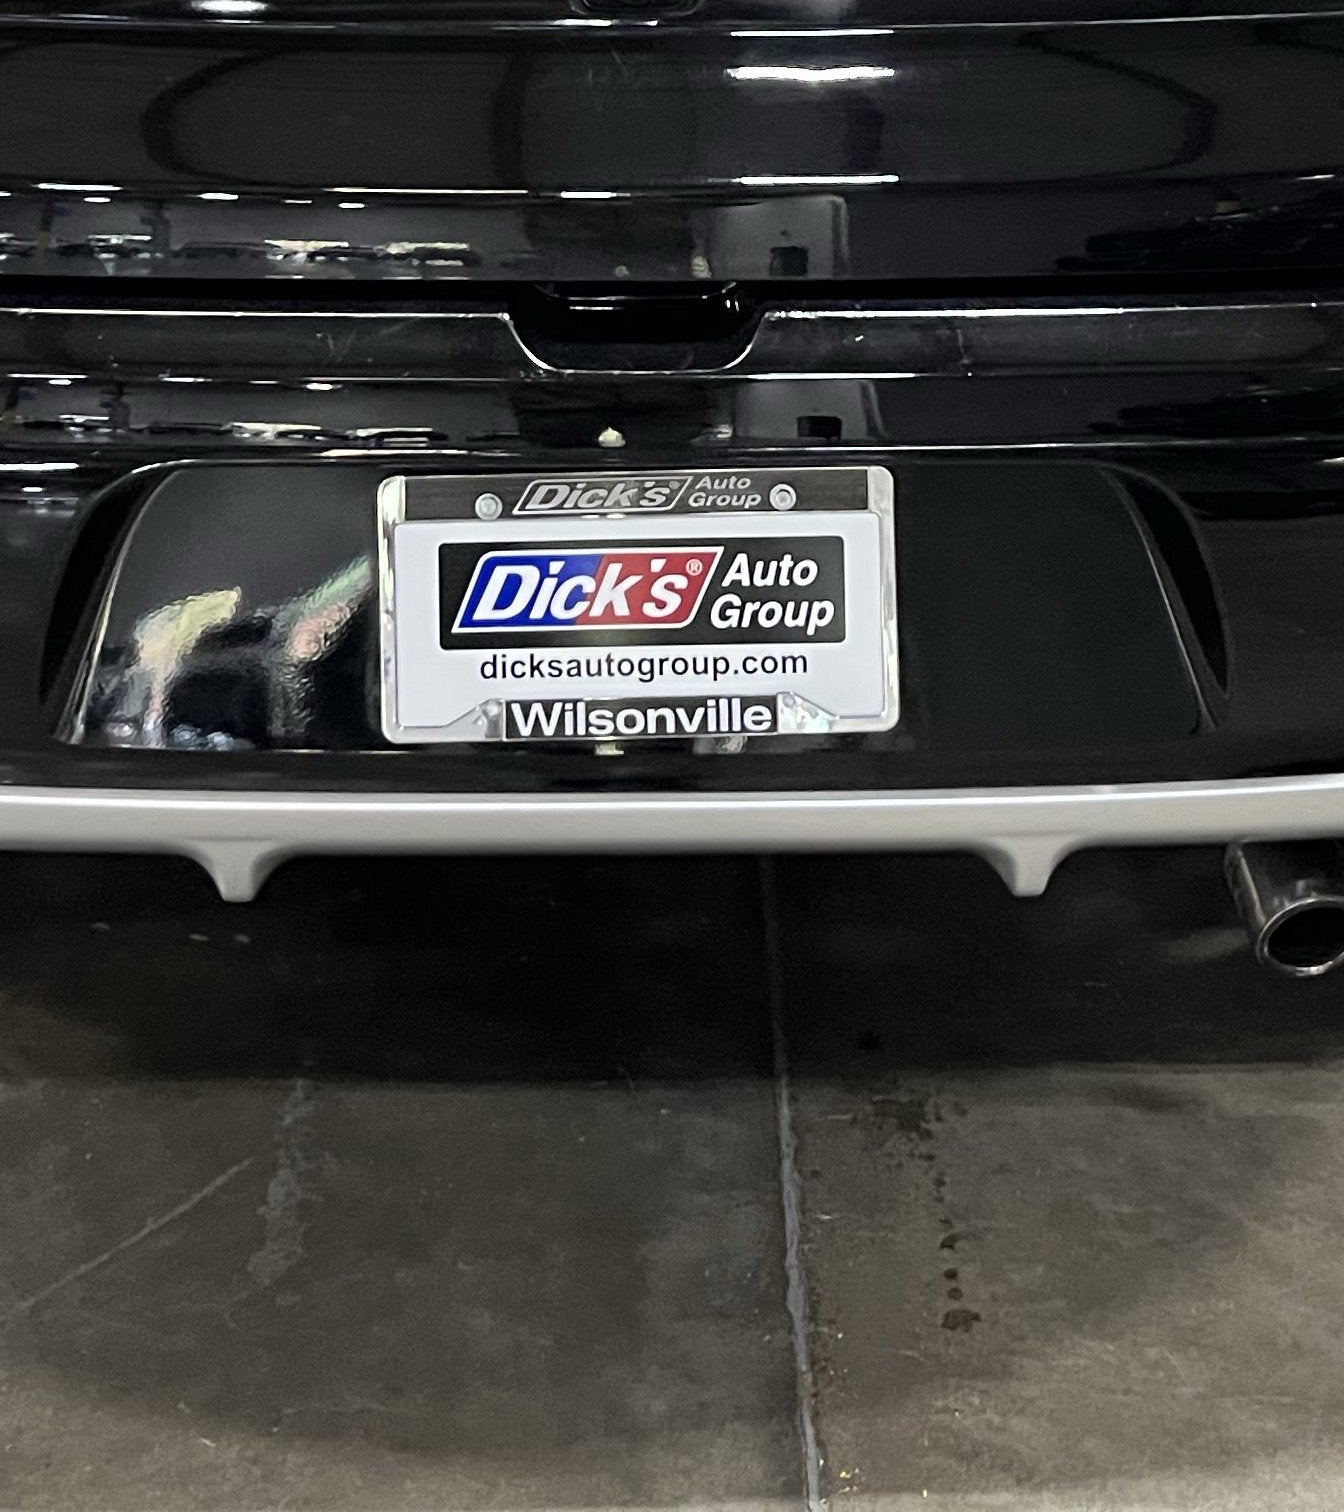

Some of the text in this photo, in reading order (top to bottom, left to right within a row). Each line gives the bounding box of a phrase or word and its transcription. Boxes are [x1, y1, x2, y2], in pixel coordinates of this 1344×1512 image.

[694, 475, 752, 490] Auto
[688, 491, 762, 509] Group
[721, 552, 819, 588] Auto
[711, 593, 835, 636] Group
[480, 653, 808, 683] dicksautogroup.com
[511, 697, 773, 738] Wilsonville
